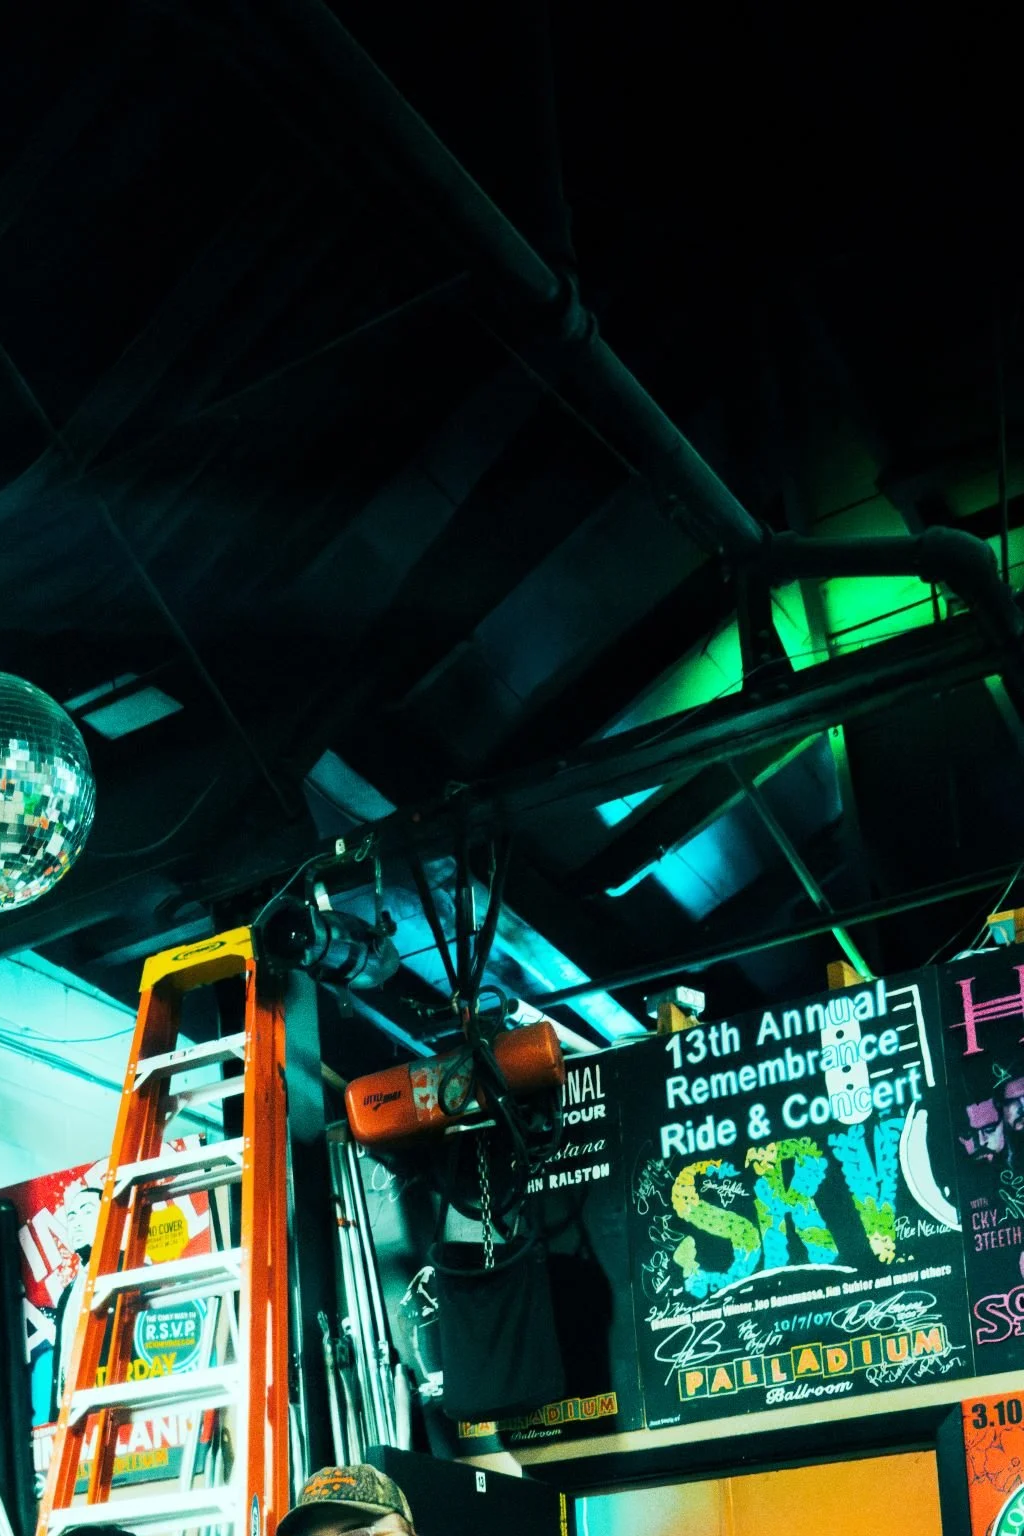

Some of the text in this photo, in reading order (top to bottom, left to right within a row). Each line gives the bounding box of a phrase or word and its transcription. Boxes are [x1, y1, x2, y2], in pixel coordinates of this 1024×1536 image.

[666, 979, 888, 1069] 13th Annual
[666, 1028, 900, 1109] Remembrance
[660, 1067, 922, 1159] Ride & Concert
[549, 1163, 609, 1190] RALSTON
[671, 1112, 905, 1299] SRV
[159, 1219, 183, 1235] COVER
[971, 1208, 998, 1231] CKY
[974, 1226, 1023, 1252] 3TEETH
[875, 1275, 892, 1288] and
[893, 1270, 919, 1286] many
[920, 1265, 952, 1280] others
[774, 1312, 833, 1333] 10/7/07
[682, 1325, 945, 1398] PALLADIUM
[765, 1380, 853, 1405] Ballroom
